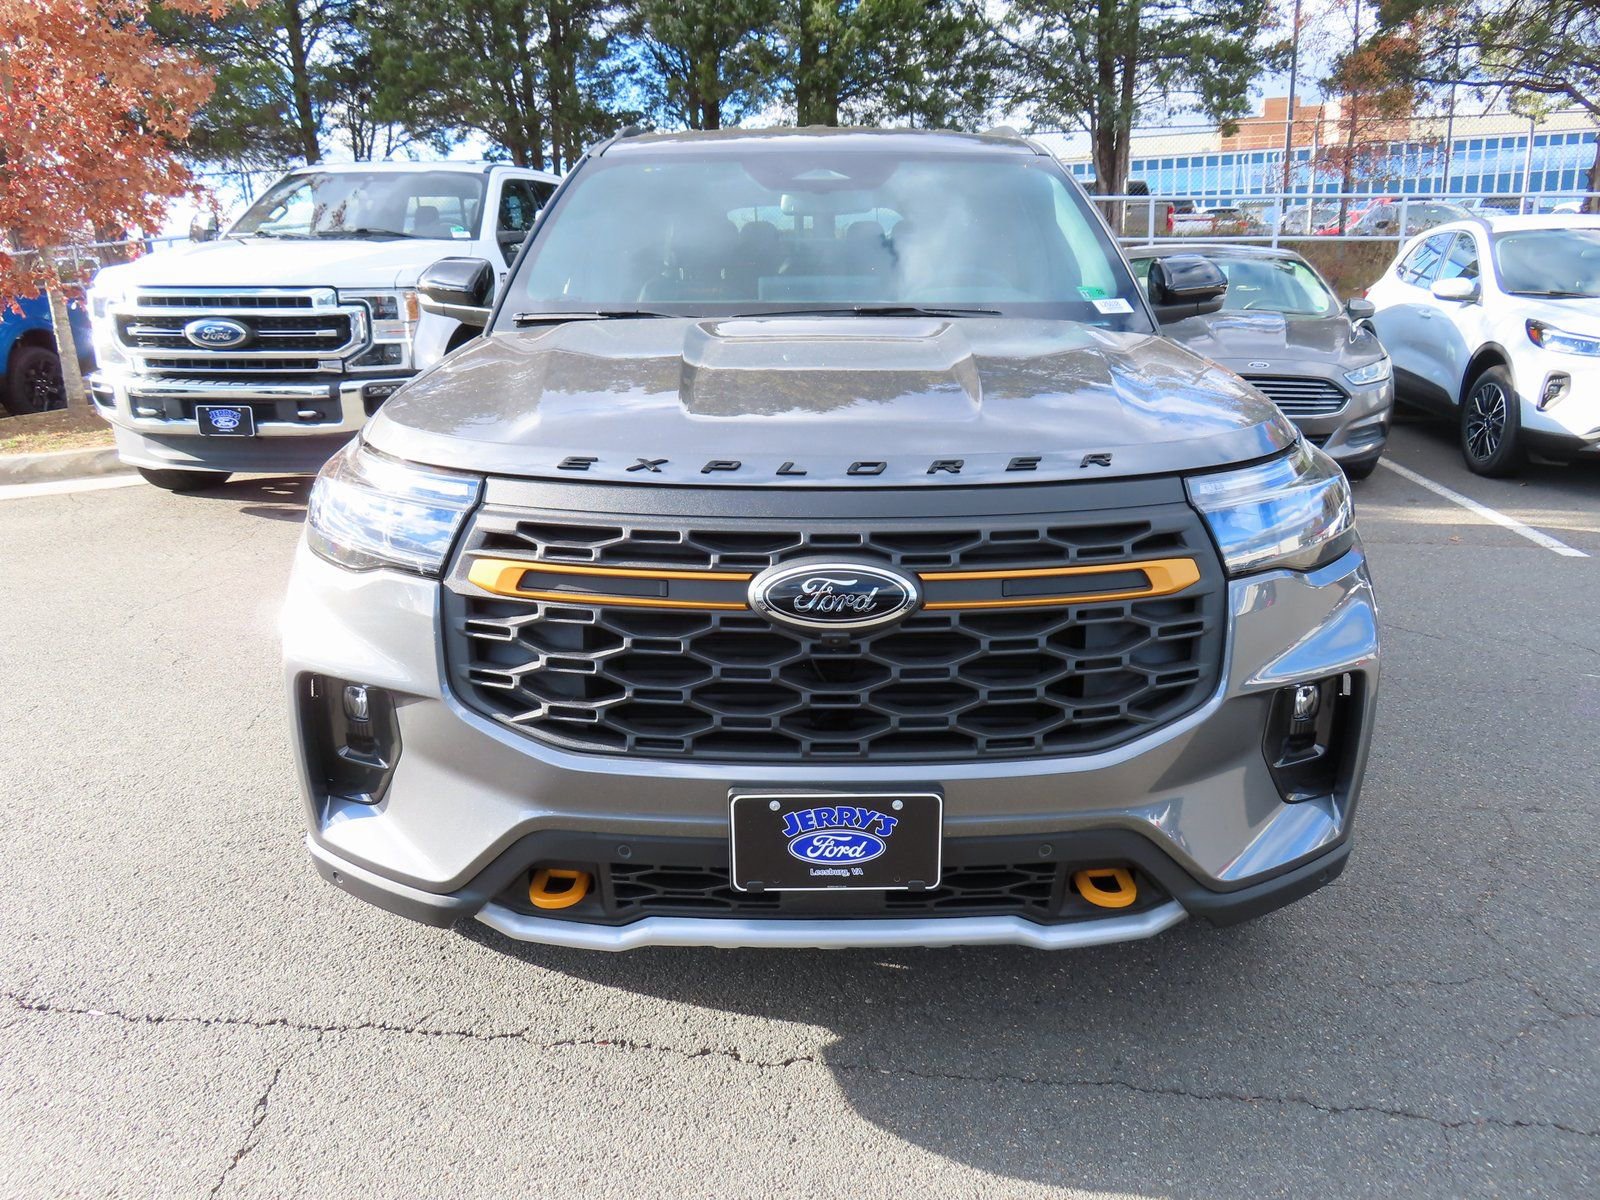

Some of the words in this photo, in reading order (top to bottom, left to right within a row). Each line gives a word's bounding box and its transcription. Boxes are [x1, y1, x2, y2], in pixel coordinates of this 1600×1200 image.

[202, 326, 231, 340] Ford
[556, 452, 1112, 477] EXPLORER
[793, 577, 879, 613] Ford
[782, 806, 898, 837] JERRY'S
[806, 835, 867, 858] Ford
[850, 867, 864, 876] VA
